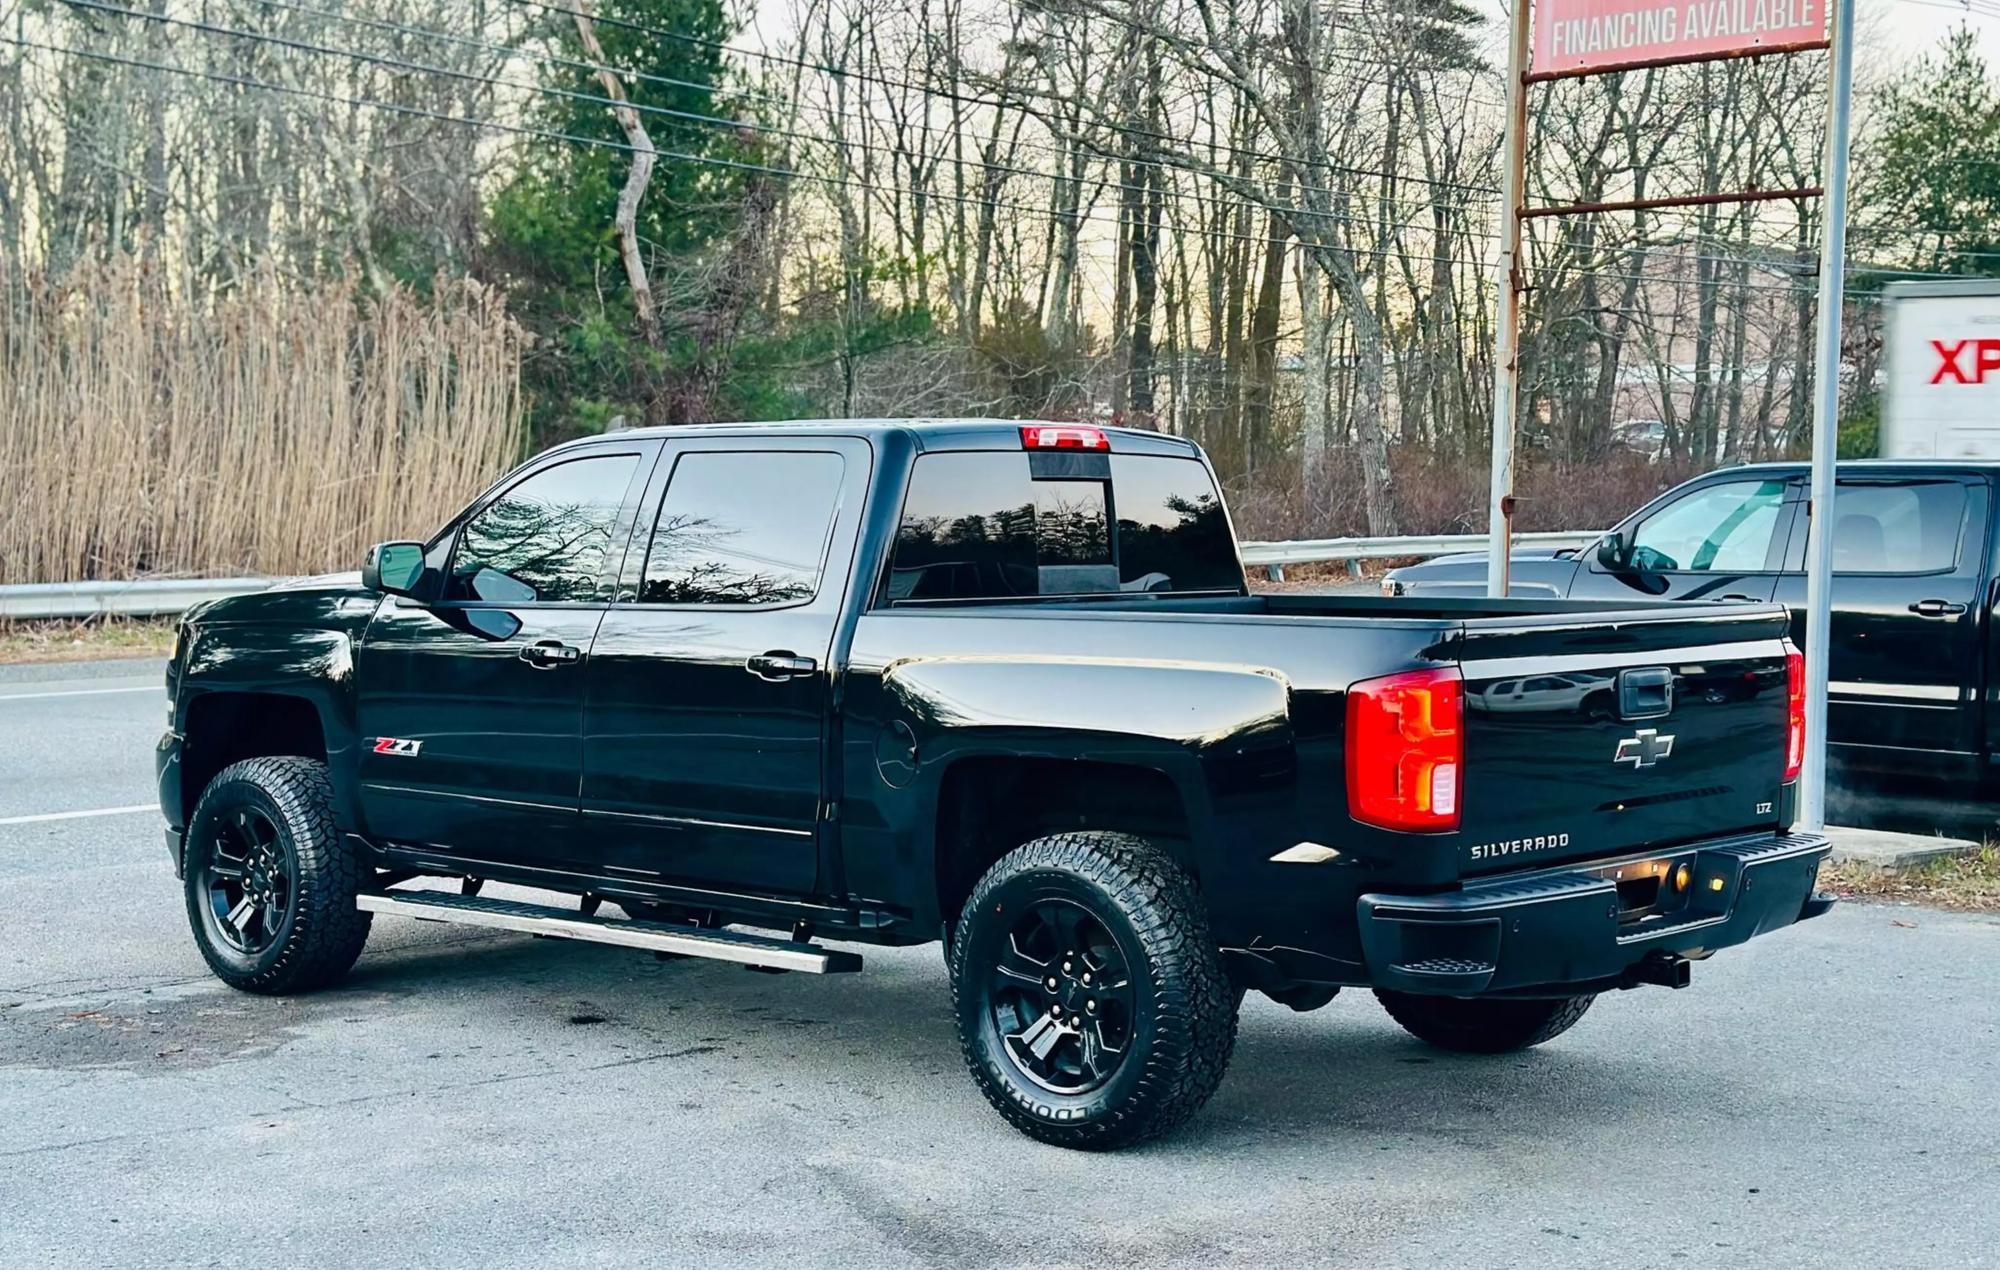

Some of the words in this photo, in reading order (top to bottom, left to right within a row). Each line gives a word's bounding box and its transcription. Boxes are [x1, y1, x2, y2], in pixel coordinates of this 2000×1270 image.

[1551, 6, 1678, 57] FINANCING
[1683, 0, 1814, 40] AVAILABLE
[373, 736, 424, 757] Z71
[1756, 802, 1772, 814] LTZ
[1471, 833, 1569, 860] SILVERADO
